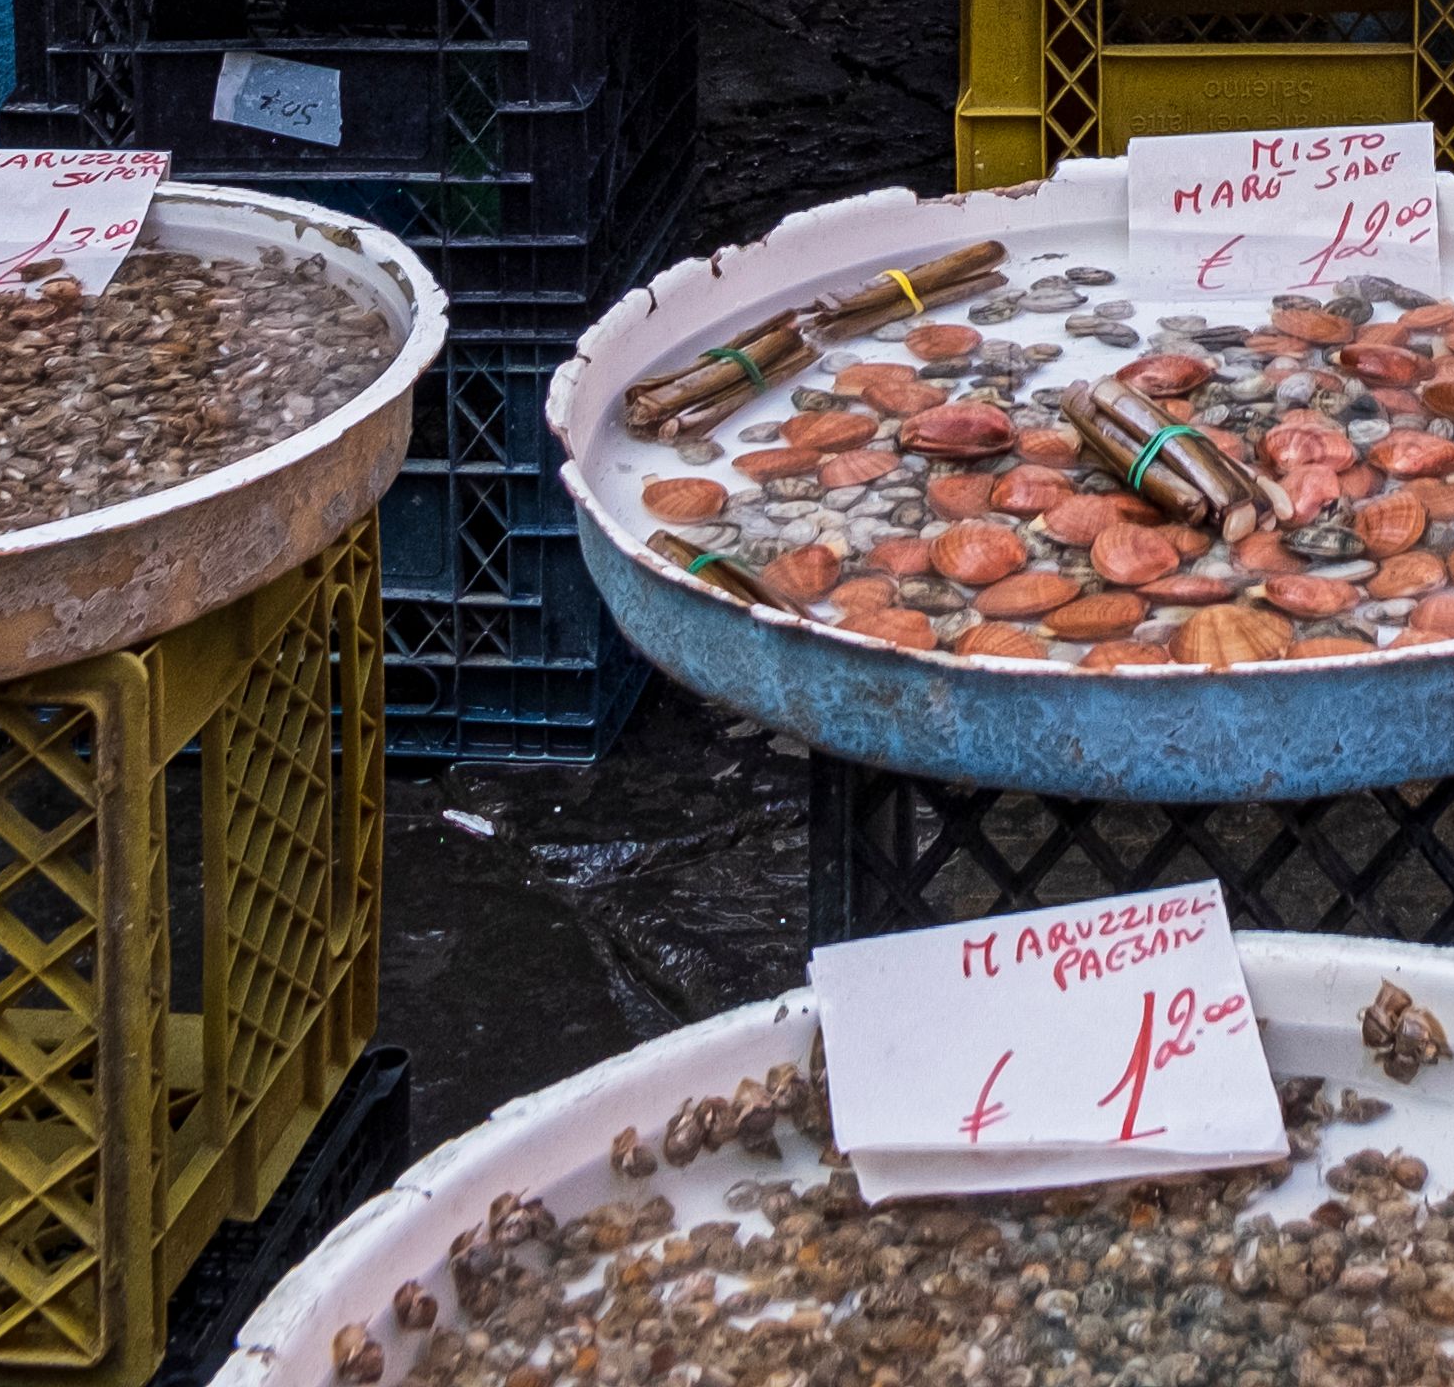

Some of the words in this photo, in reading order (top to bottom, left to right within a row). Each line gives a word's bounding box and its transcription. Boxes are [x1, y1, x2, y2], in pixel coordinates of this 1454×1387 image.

[1251, 132, 1386, 172] MISTO
[1173, 167, 1297, 214] MARE
[1196, 234, 1244, 291] €
[958, 1049, 1014, 1144] €
